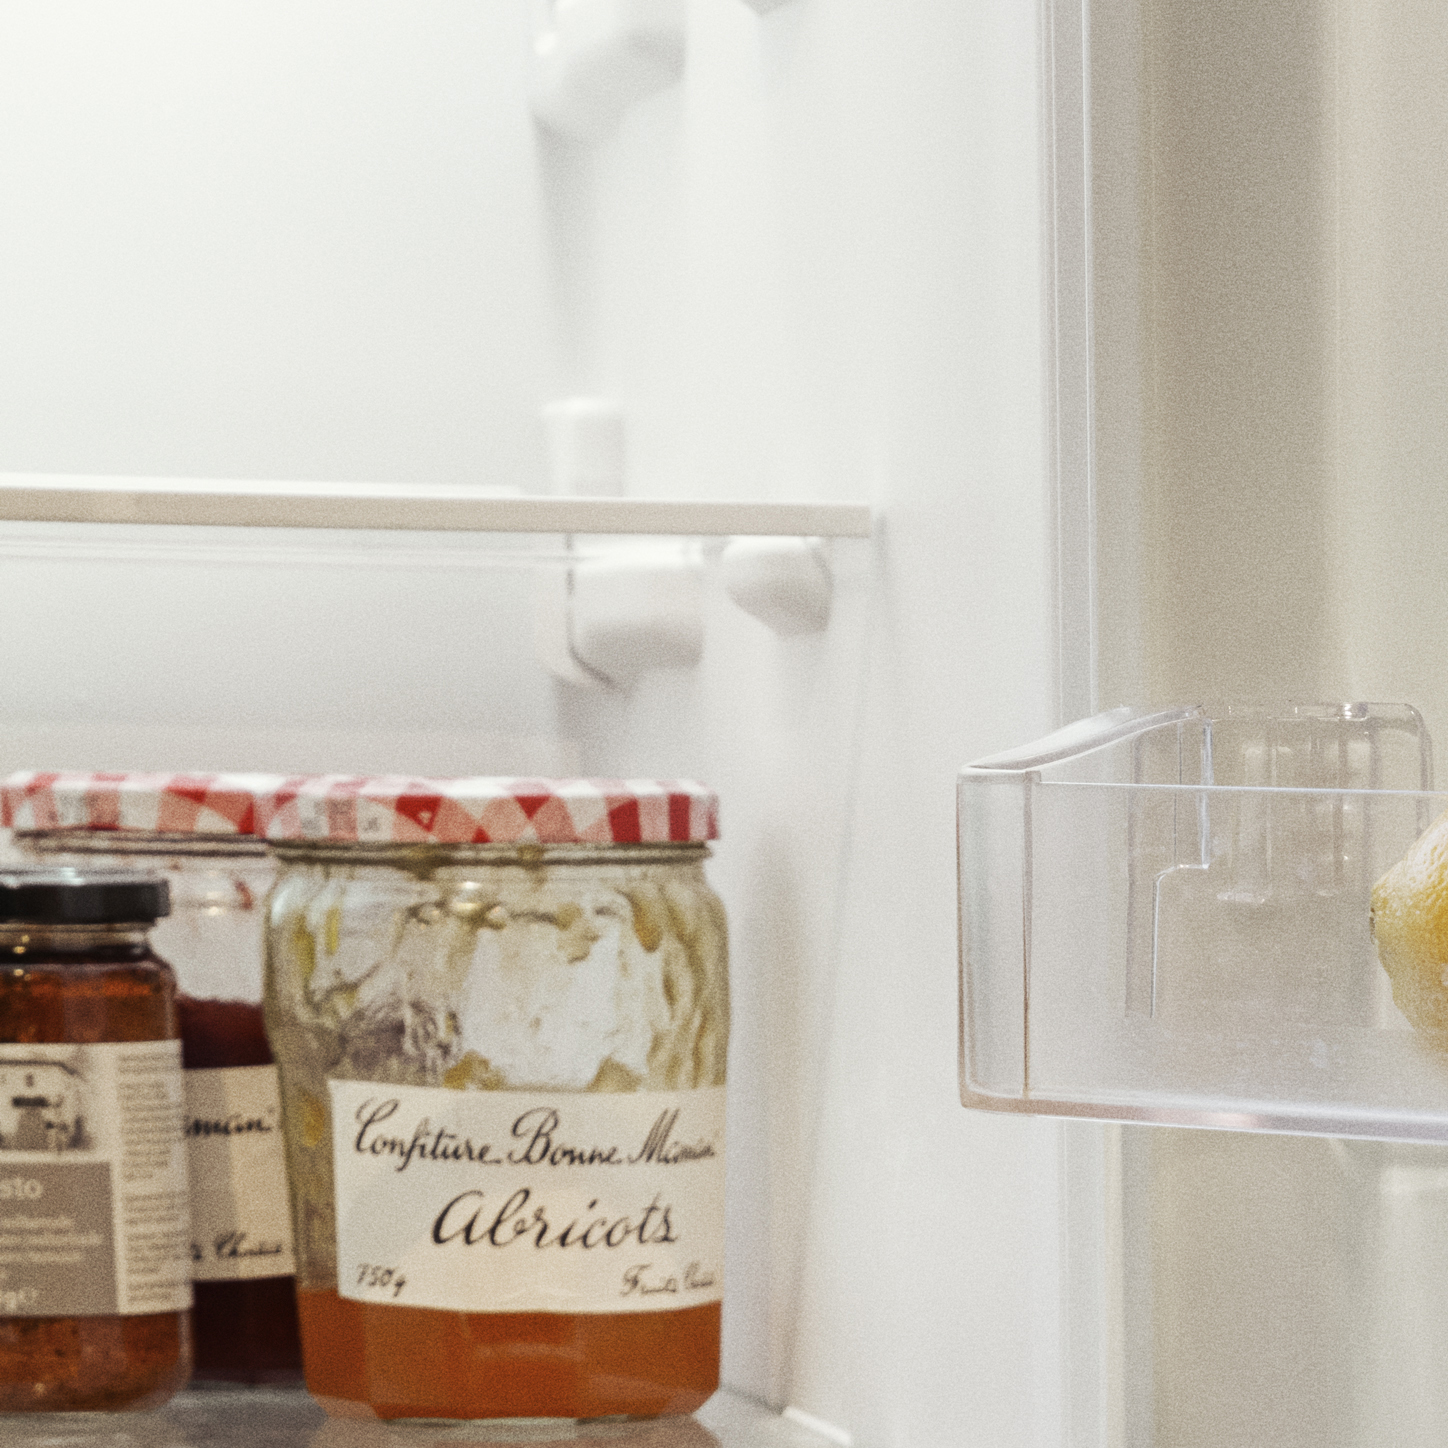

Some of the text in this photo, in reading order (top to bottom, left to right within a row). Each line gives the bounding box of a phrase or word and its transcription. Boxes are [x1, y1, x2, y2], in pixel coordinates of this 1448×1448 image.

[354, 1098, 504, 1173] Confiture
[506, 1106, 625, 1168] Bonne
[430, 1187, 678, 1250] Abricots
